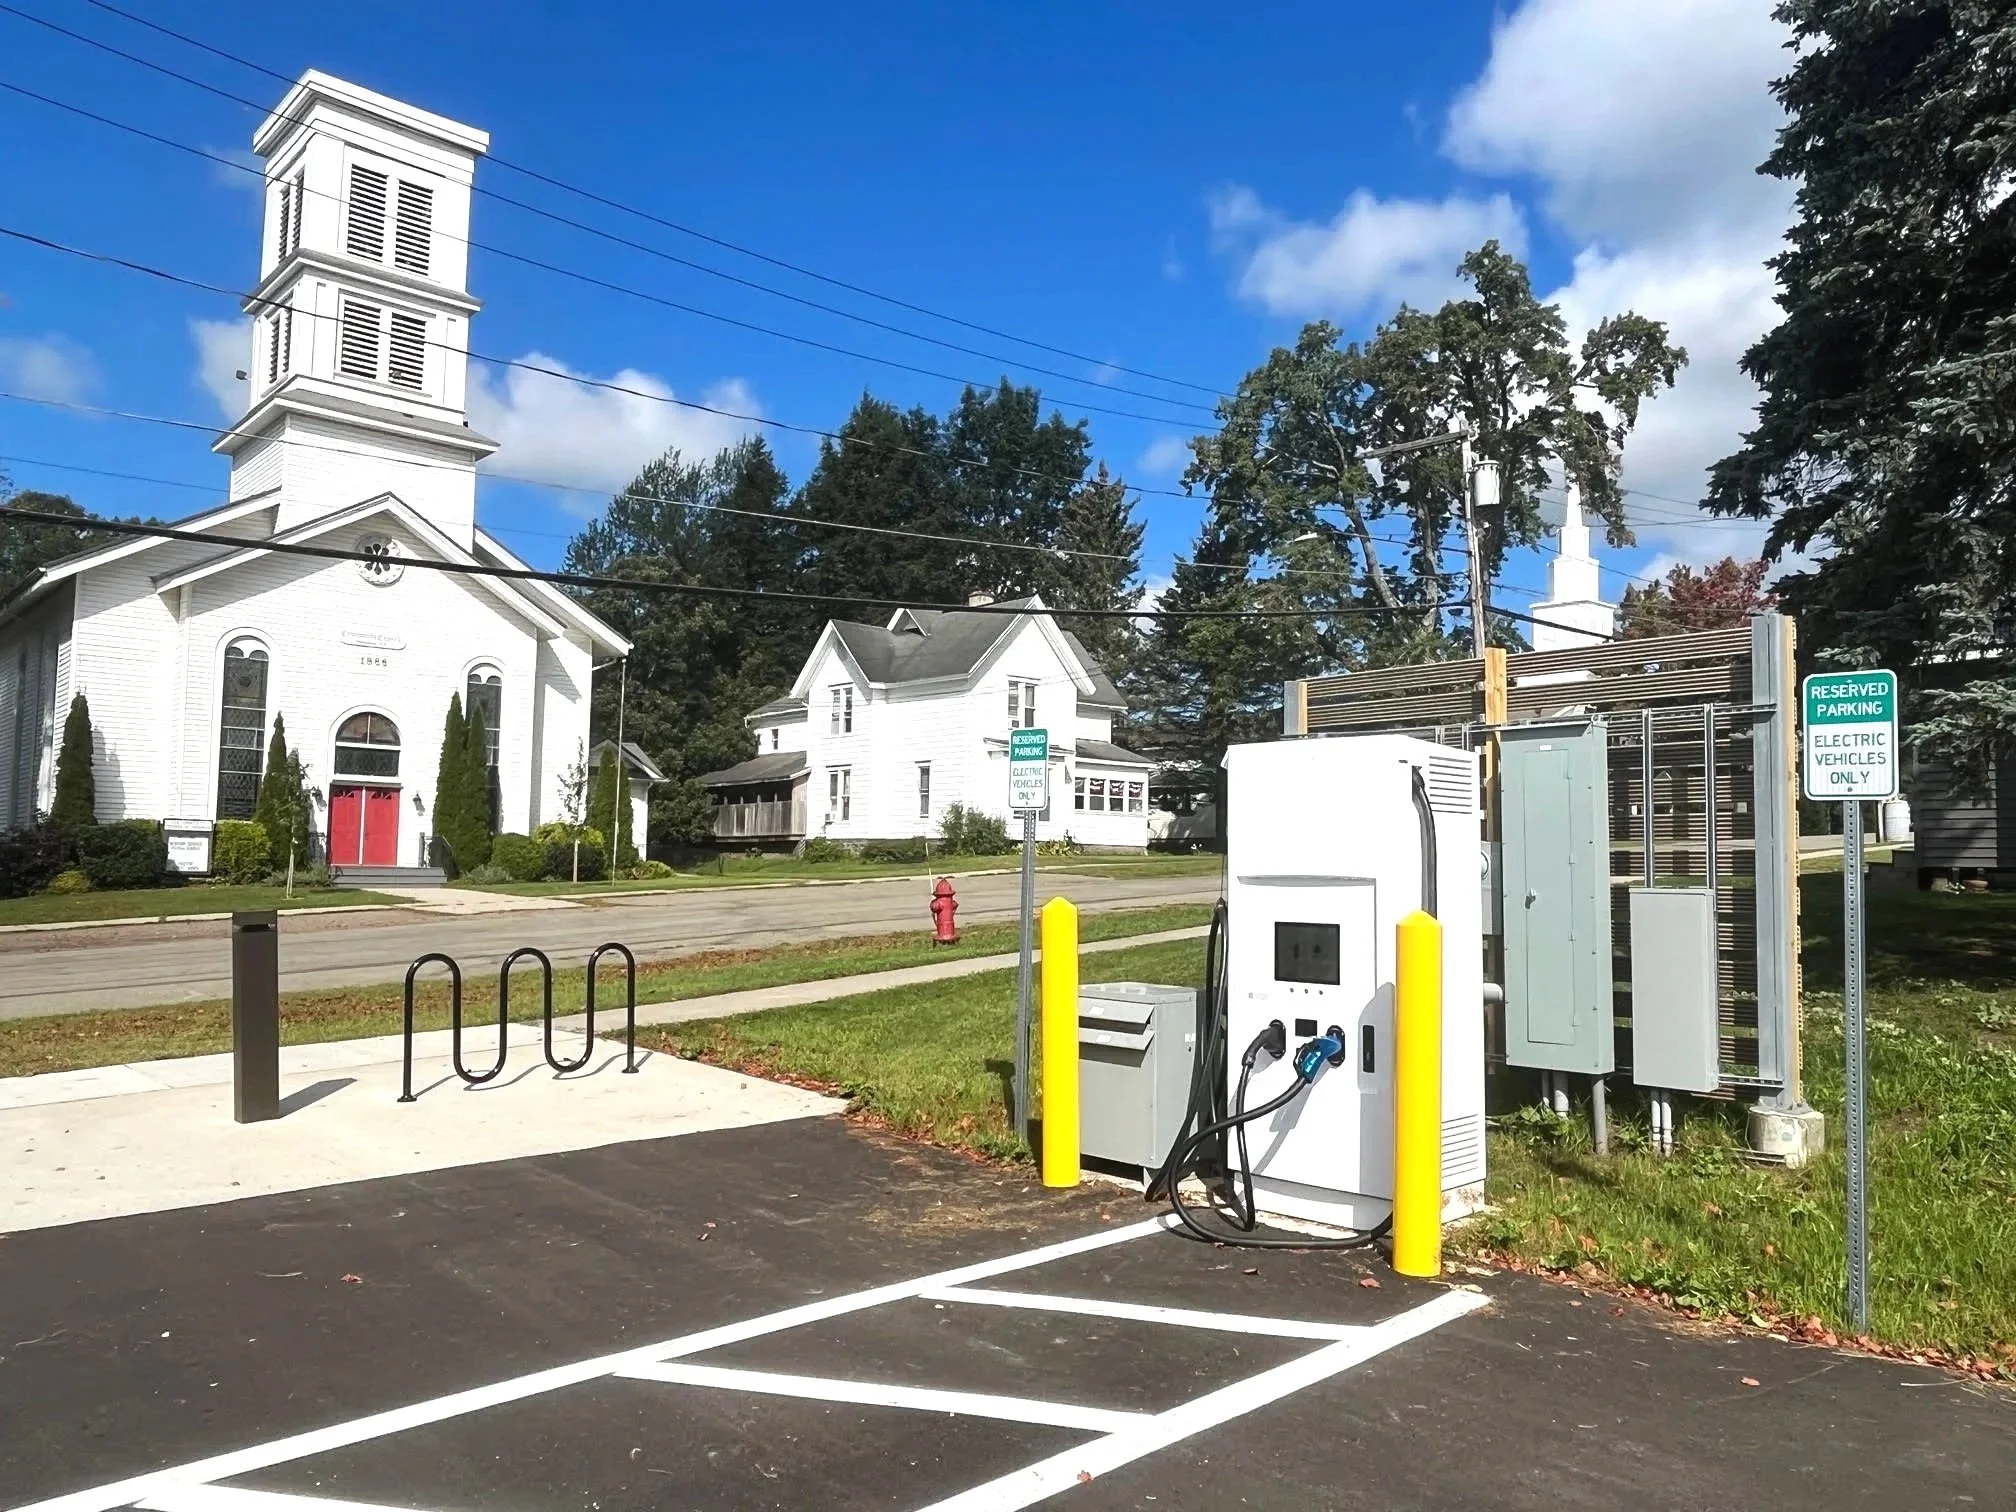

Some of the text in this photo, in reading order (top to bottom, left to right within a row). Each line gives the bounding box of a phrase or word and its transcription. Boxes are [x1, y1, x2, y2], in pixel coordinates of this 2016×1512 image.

[1811, 682, 1889, 699] RESERVED
[1816, 701, 1884, 718] PARKING
[1012, 734, 1046, 745] RESERVED
[1814, 733, 1886, 748] ELECTRIC
[1014, 747, 1043, 757] PARKING
[1815, 752, 1887, 766] VEHICLES
[1013, 767, 1043, 777] ELECTRIC
[1830, 770, 1870, 784] ONLY
[1013, 779, 1043, 789] VEHICLES
[1018, 791, 1036, 801] ONLY
